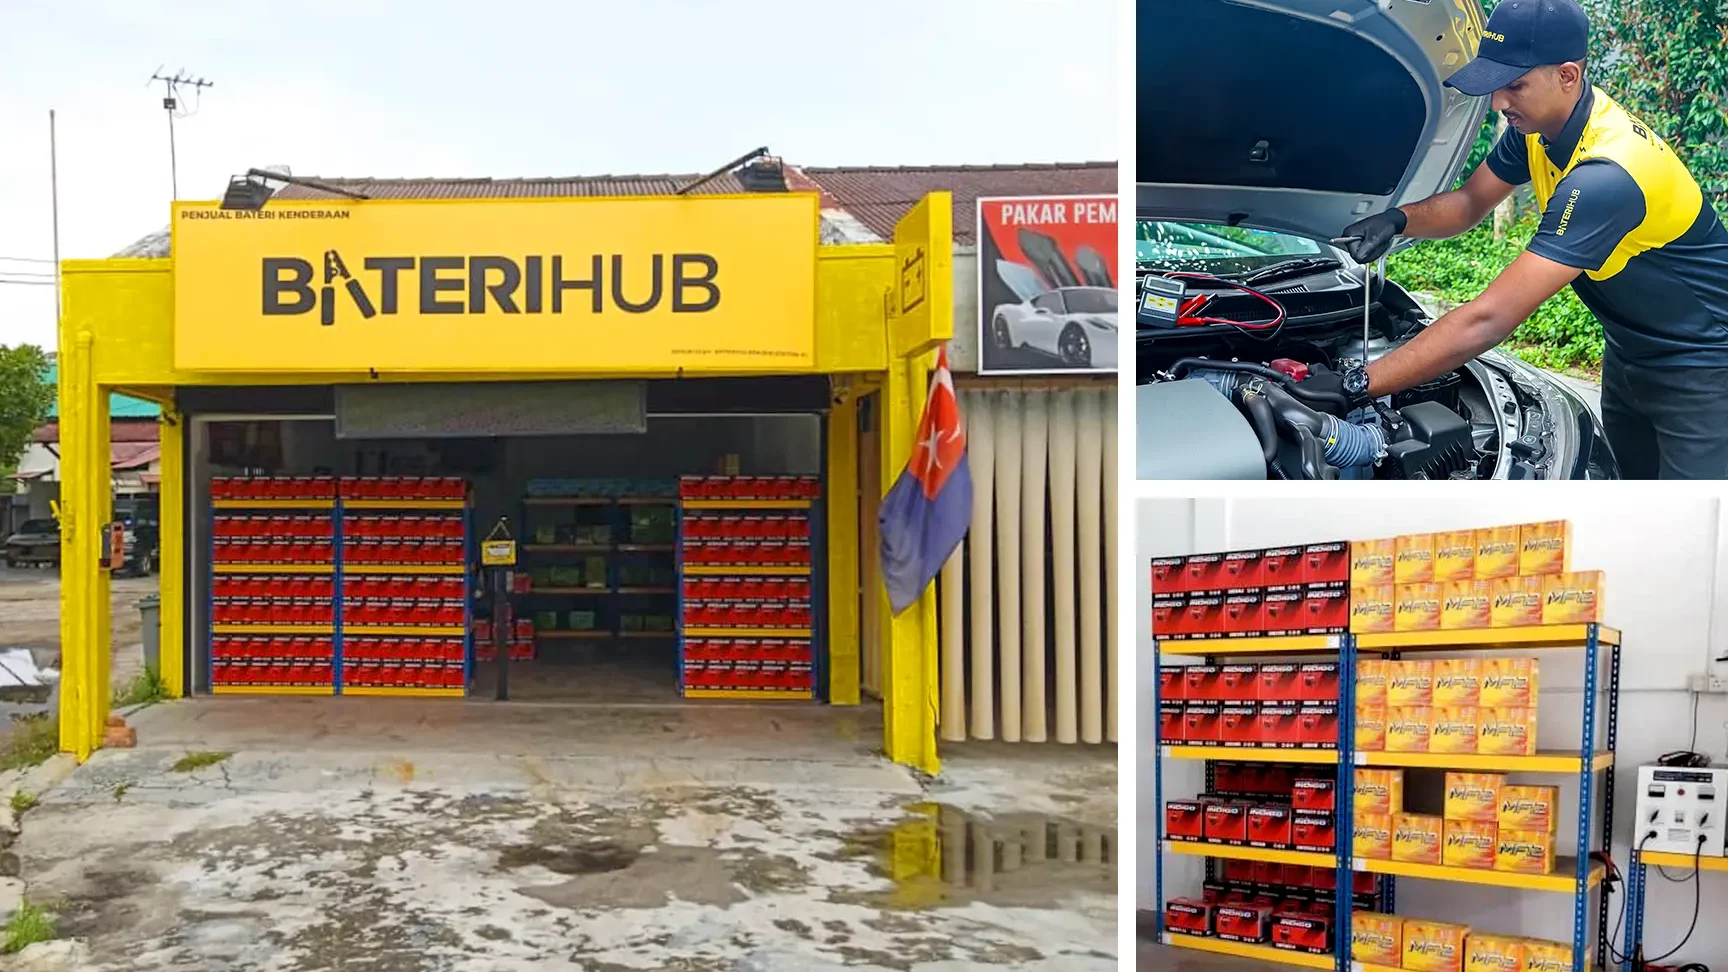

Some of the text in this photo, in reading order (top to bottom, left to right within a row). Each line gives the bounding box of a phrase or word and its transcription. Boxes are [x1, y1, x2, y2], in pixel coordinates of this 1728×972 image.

[181, 210, 350, 220] PENJUAL BATERI KENDERAAN
[1001, 203, 1068, 225] PAKAR
[262, 249, 720, 326] BATERIHUB
